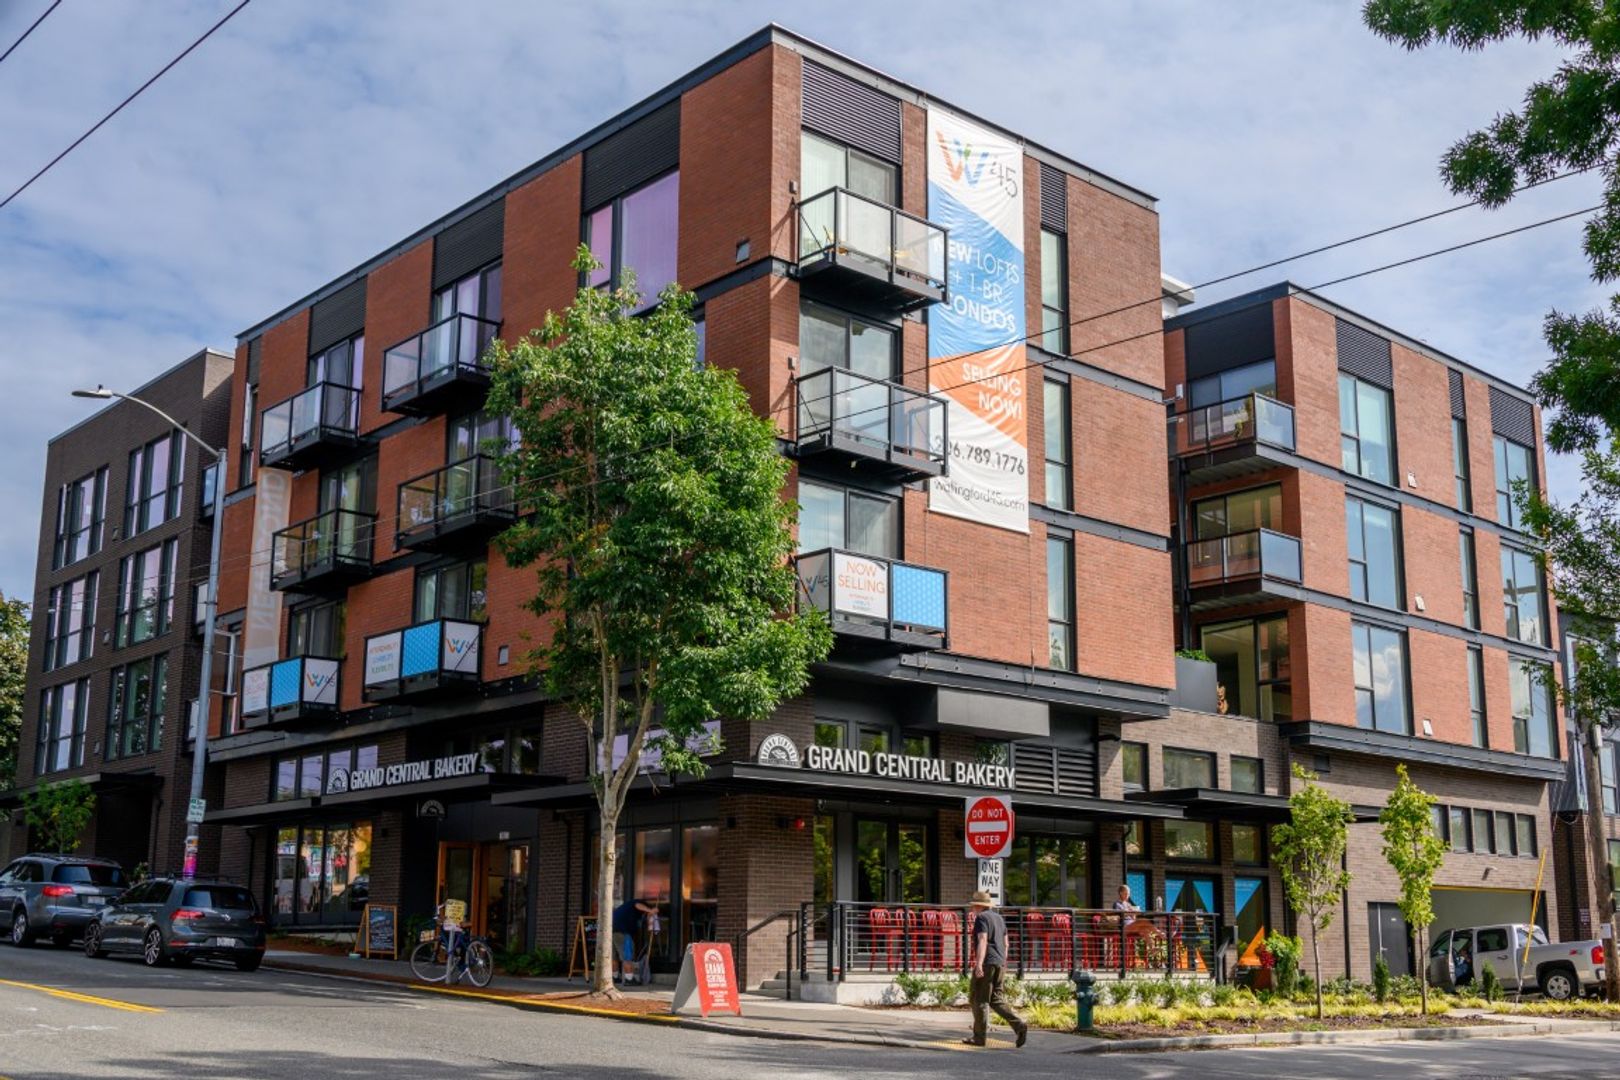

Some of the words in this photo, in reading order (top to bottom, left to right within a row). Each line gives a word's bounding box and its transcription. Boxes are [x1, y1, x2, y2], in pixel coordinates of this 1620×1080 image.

[977, 249, 1020, 284] LOFTS
[845, 560, 878, 578] NOW
[838, 574, 886, 595] SELLING
[350, 768, 385, 790] GRAND
[386, 760, 432, 785] CENTRAL
[434, 752, 479, 779] BAKERY
[808, 745, 871, 774] GRAND
[875, 751, 951, 782] CENTRAL
[955, 761, 1016, 788] BAKERY
[971, 808, 983, 819] DO
[987, 808, 1004, 818] NOT
[974, 835, 1001, 845] ENTER
[981, 861, 1000, 875] ONE
[981, 875, 1000, 887] WAY
